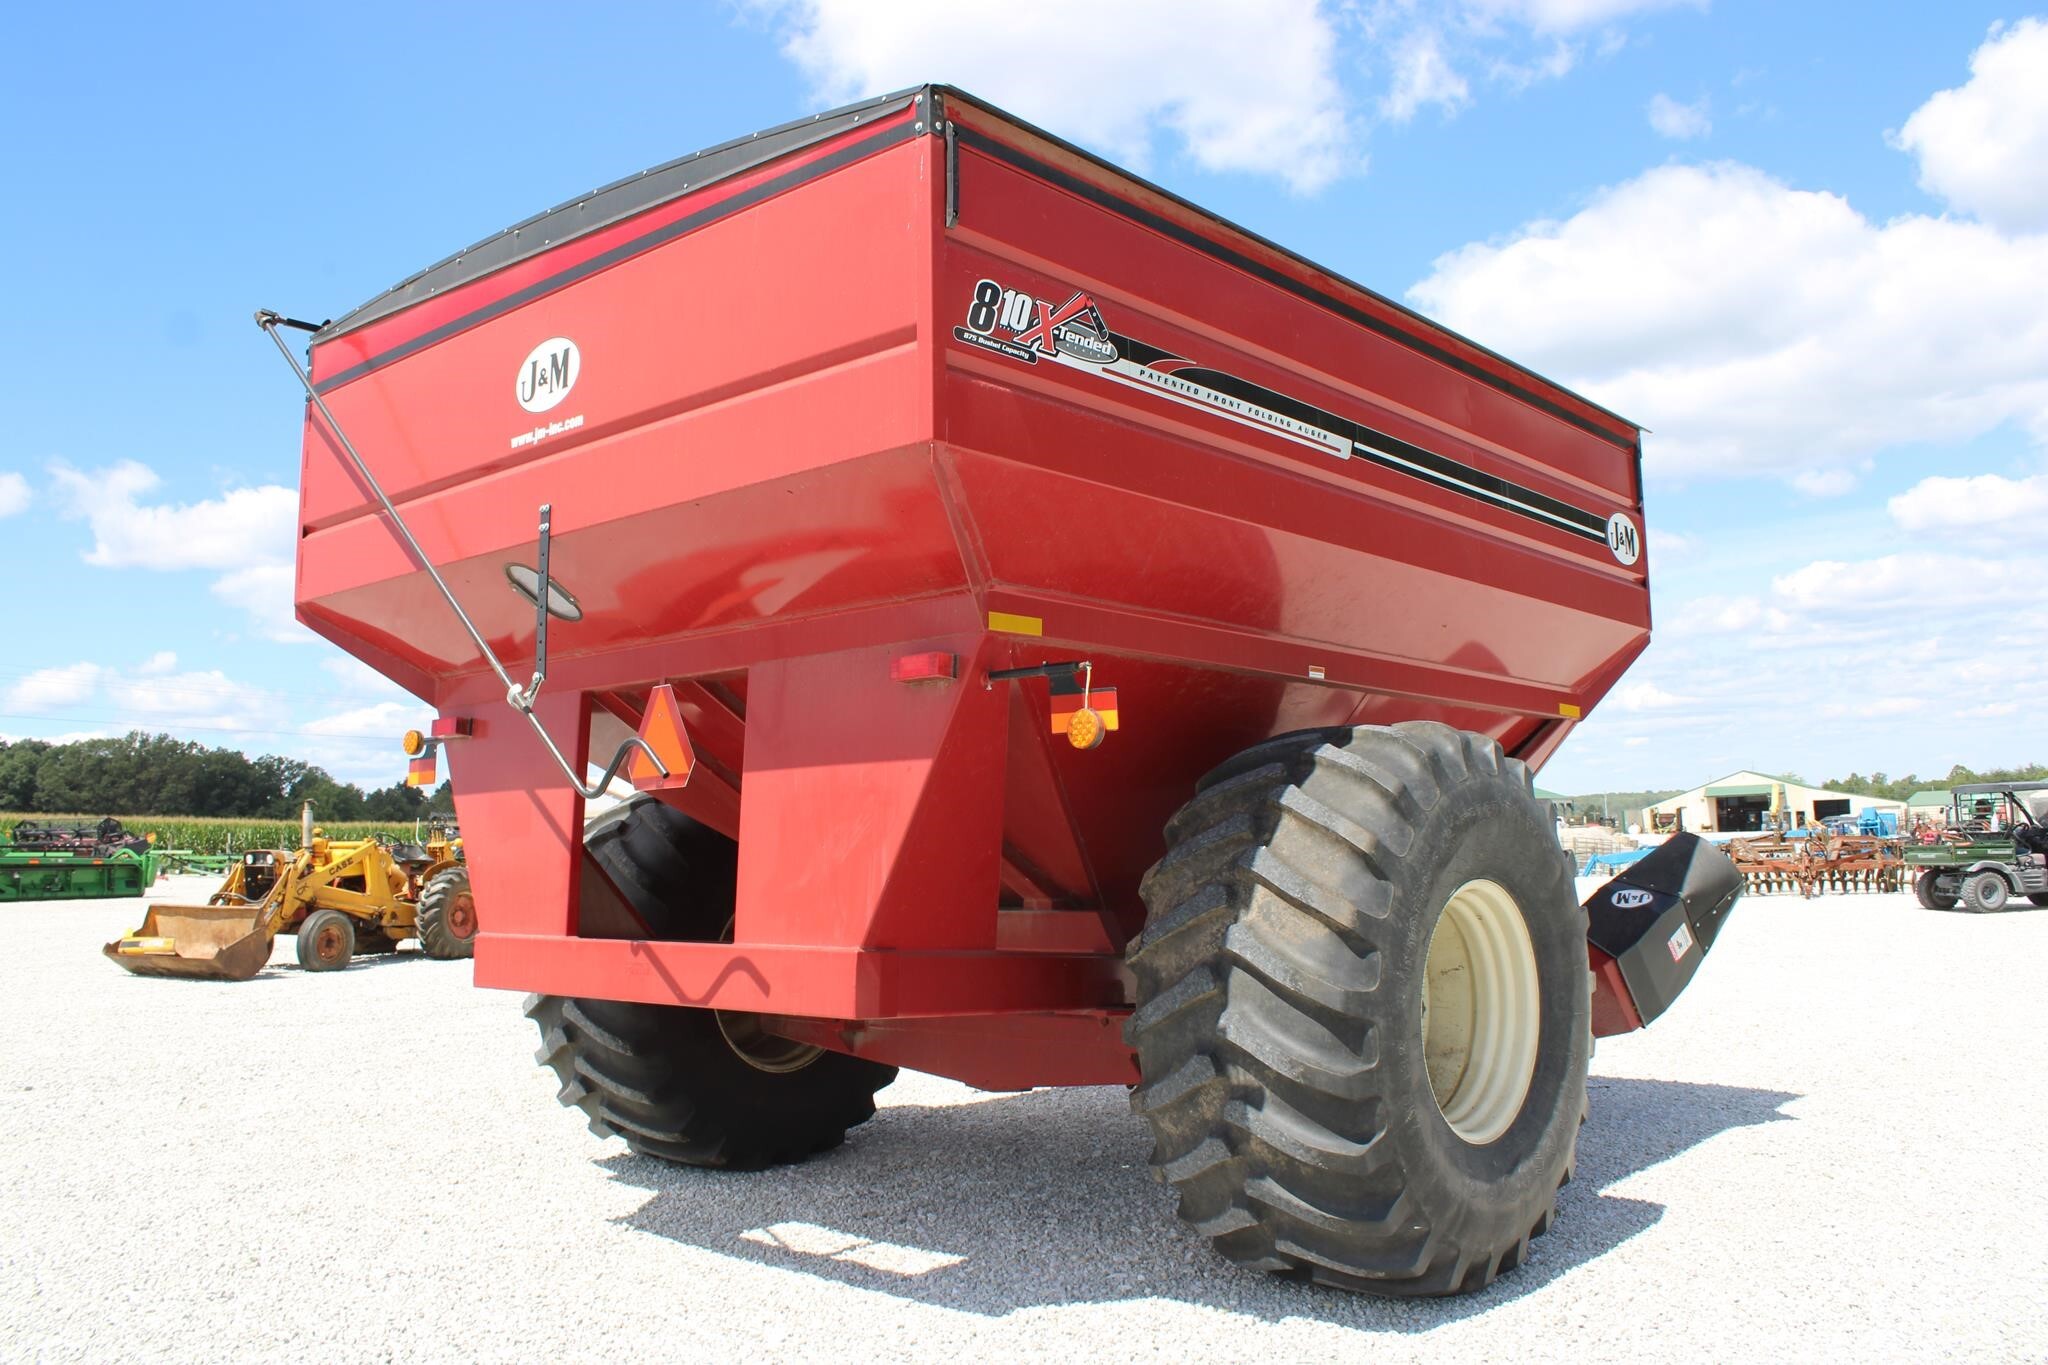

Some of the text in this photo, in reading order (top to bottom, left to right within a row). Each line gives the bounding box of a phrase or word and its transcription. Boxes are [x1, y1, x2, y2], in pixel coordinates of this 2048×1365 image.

[967, 279, 1033, 334] 810
[963, 332, 1030, 360] 875 Bushel Capacity
[521, 347, 570, 402] J&M
[1139, 369, 1328, 441] PATENTED FRONT FOLDING AUGER
[510, 415, 584, 448] www.jm-inc.com
[1610, 521, 1635, 557] J&M
[329, 858, 354, 876] CASE
[1616, 892, 1650, 904] J&M
